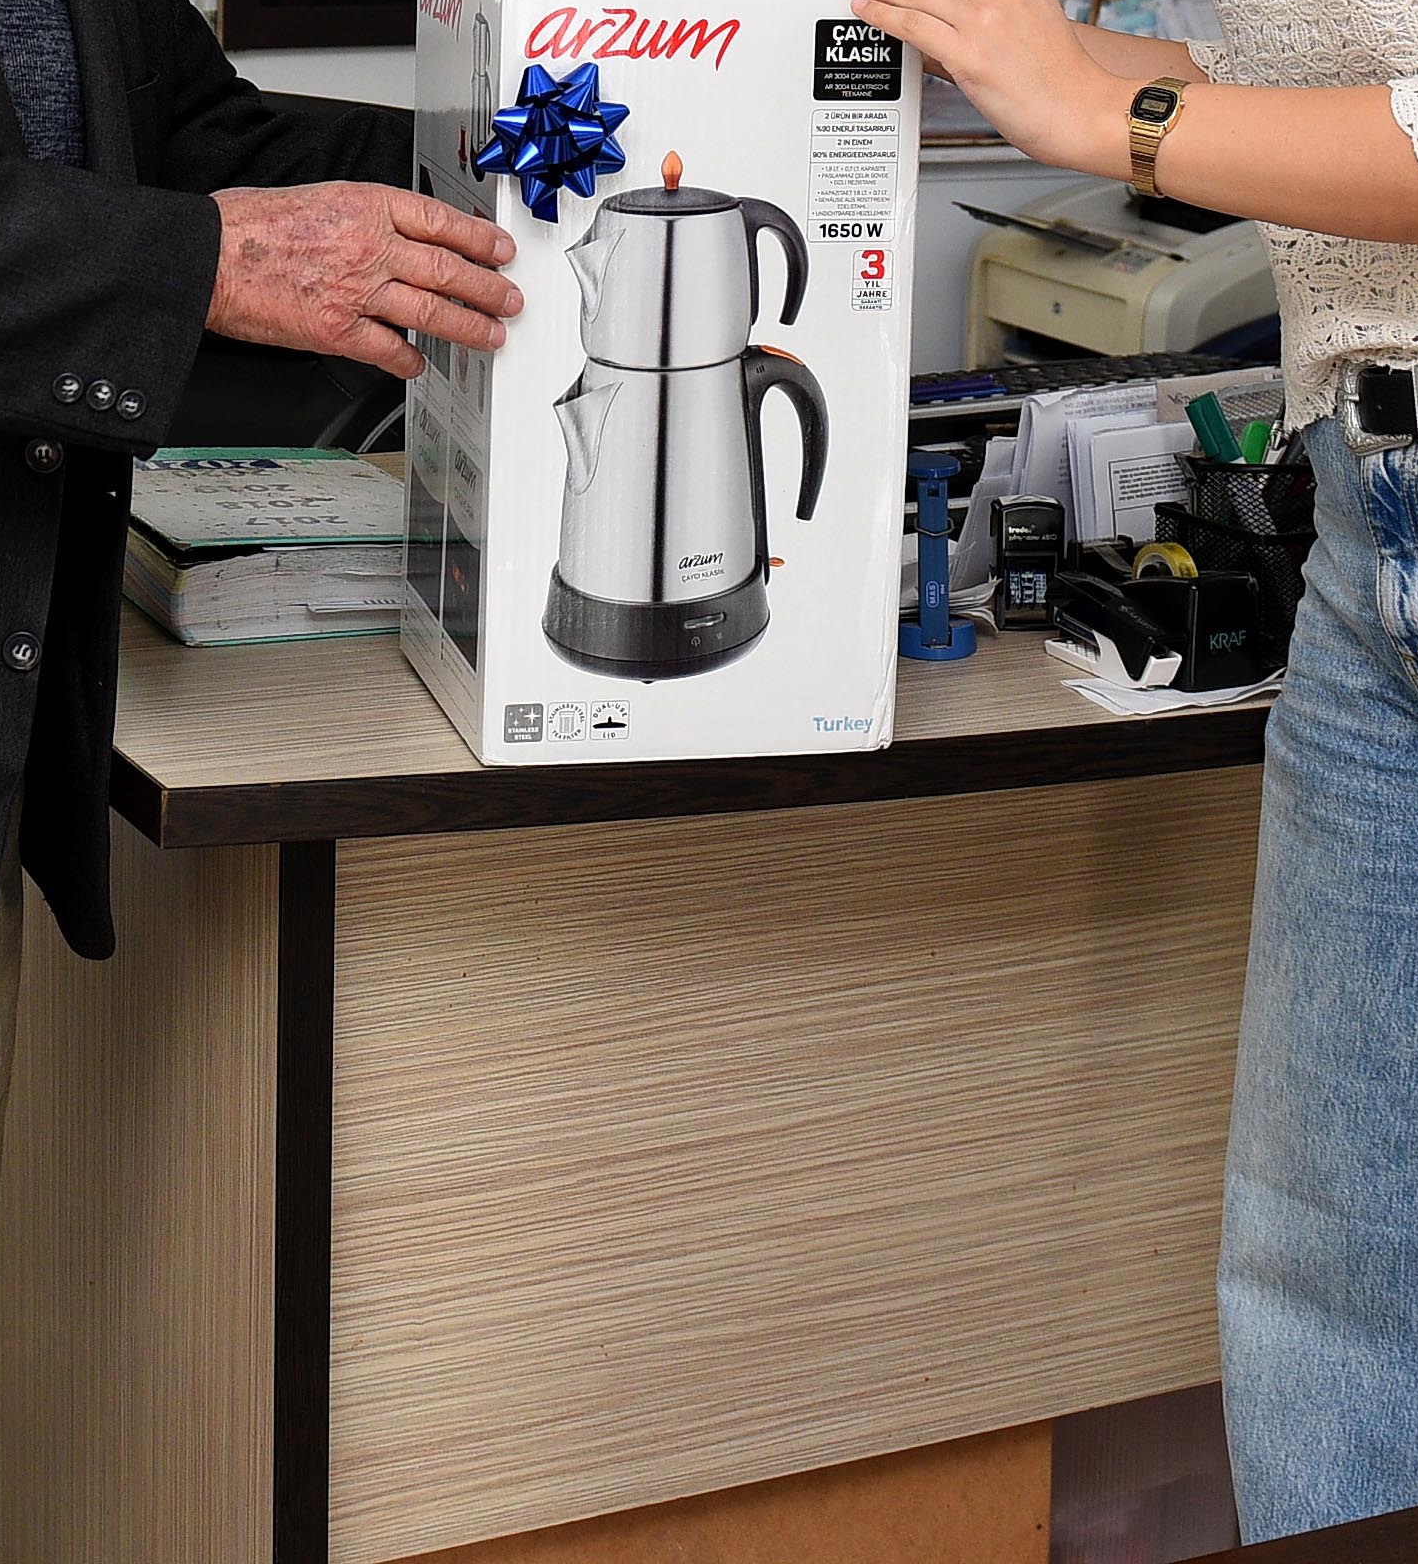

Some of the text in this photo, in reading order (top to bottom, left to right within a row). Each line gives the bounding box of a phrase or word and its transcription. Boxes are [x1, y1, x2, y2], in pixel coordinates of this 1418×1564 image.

[524, 7, 741, 71] arzum
[825, 43, 893, 63] KLASİK
[824, 72, 833, 80] AR
[834, 72, 850, 80] 3004
[851, 72, 863, 82] ÇAY
[824, 83, 834, 91] AR
[834, 83, 850, 91] 3004
[831, 111, 851, 120] ÜRÜN
[851, 111, 864, 120] BİR
[864, 112, 888, 120] ARADA
[816, 124, 896, 133] %90 ENERJİ TASARRUFU
[812, 151, 827, 159] 90%
[819, 223, 884, 238] 1650 W
[860, 249, 885, 280] 3
[864, 280, 881, 288] YIL
[856, 290, 888, 298] JAHRE
[245, 515, 349, 526] 2017
[678, 552, 724, 570] arzum
[1209, 630, 1247, 653] KRAF
[592, 701, 628, 719] DUAL-USE
[812, 716, 874, 734] Turkey
[602, 731, 616, 739] LID
